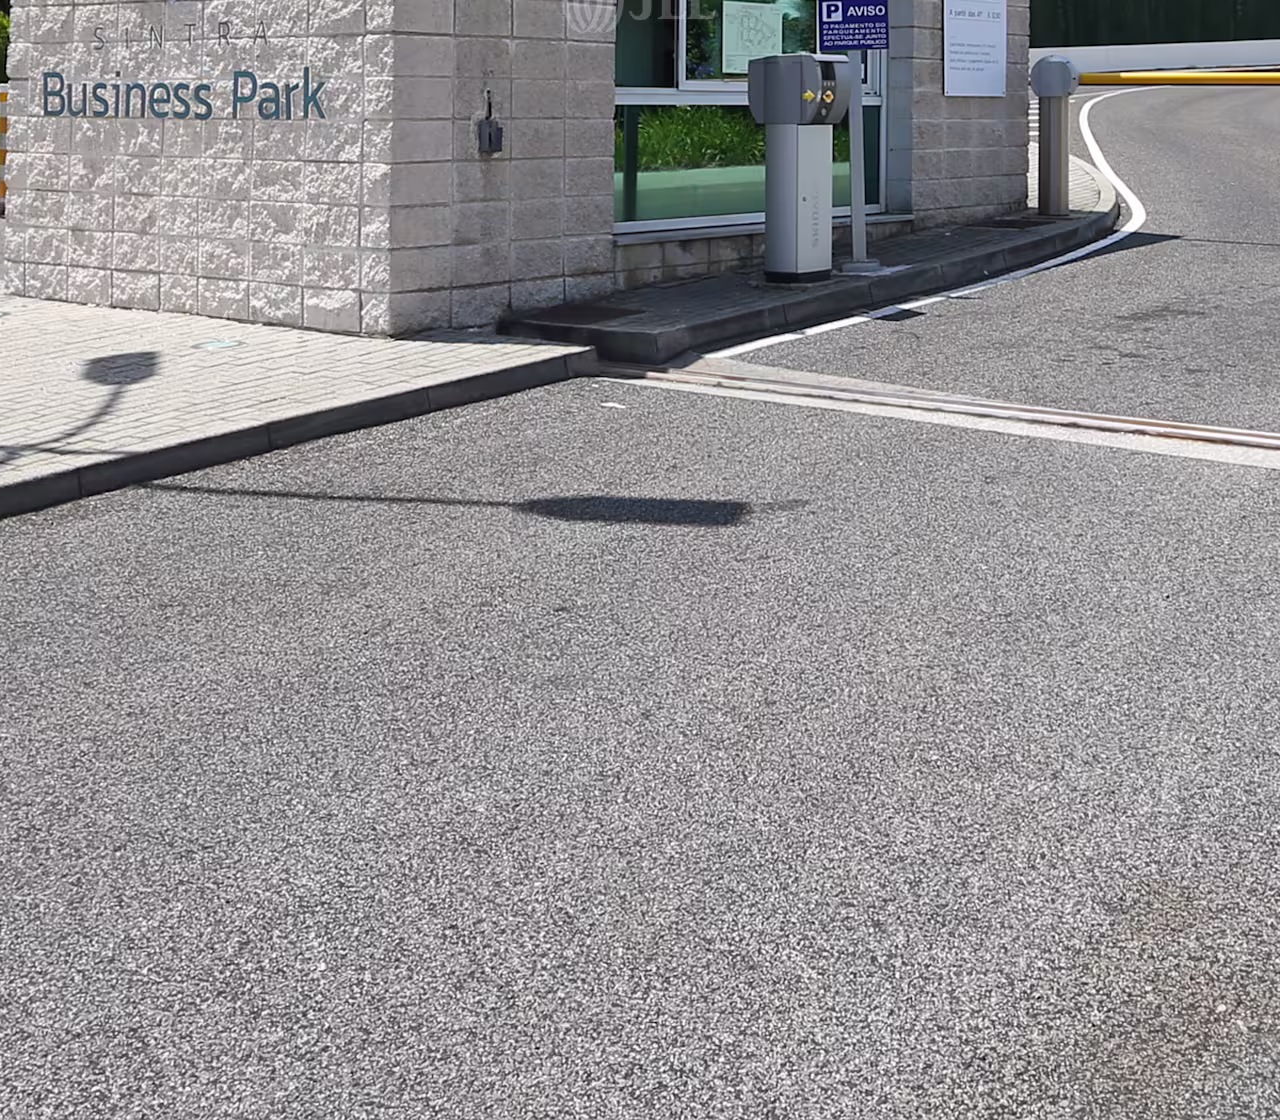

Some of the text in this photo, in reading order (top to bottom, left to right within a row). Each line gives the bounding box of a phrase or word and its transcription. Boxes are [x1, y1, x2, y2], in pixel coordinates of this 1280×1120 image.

[826, 4, 886, 19] P AVISO
[93, 21, 268, 50] SINTRA
[42, 67, 326, 120] Business Park
